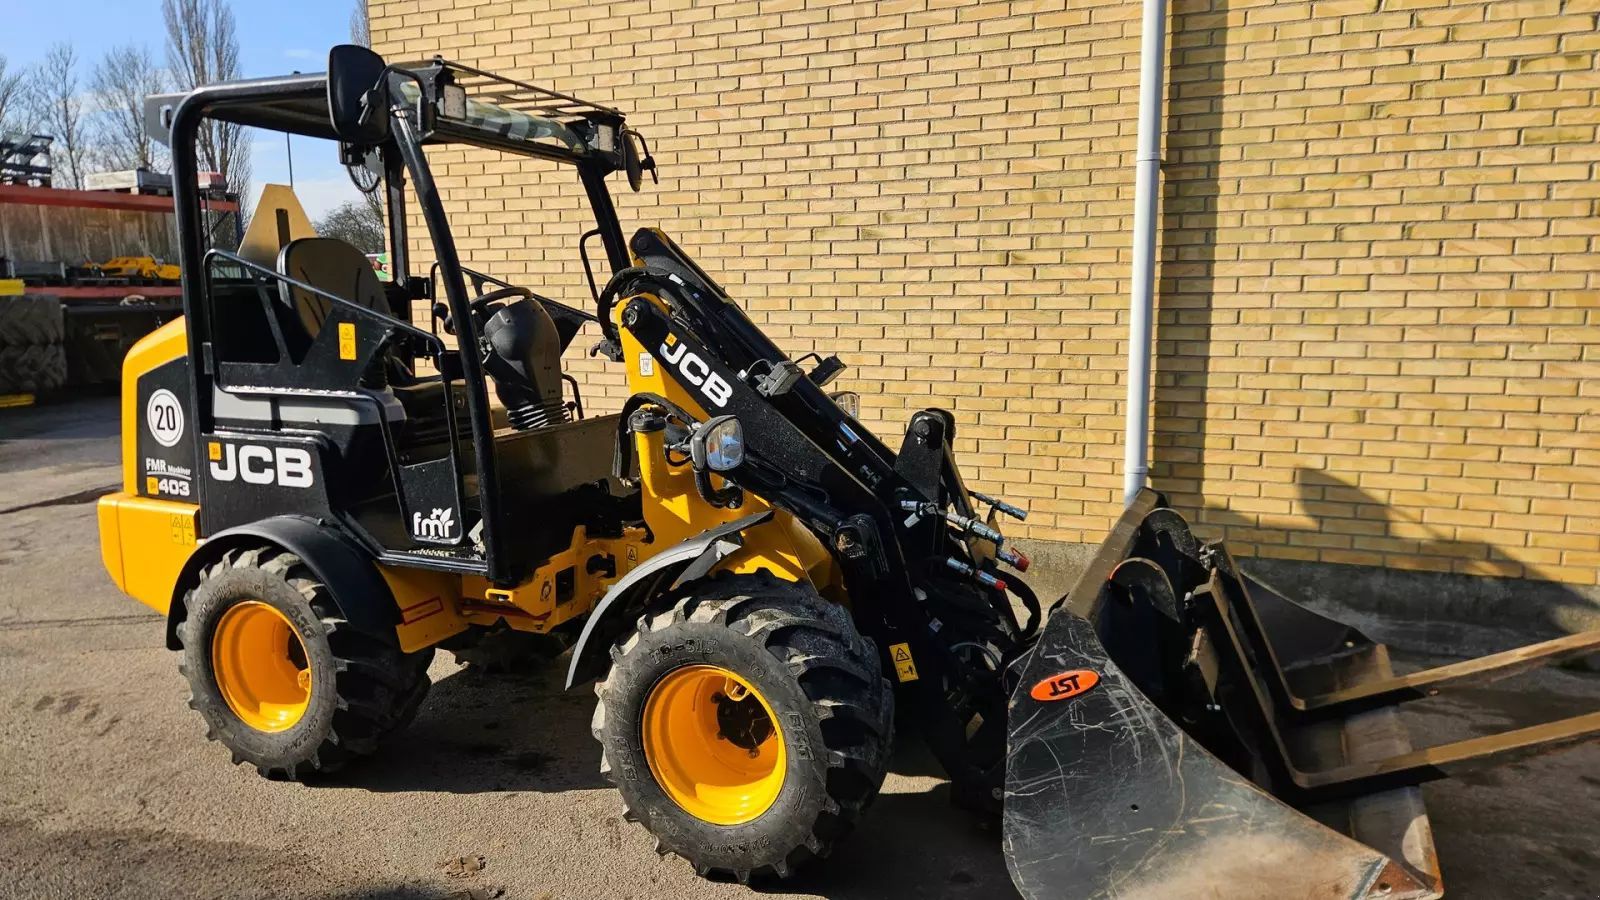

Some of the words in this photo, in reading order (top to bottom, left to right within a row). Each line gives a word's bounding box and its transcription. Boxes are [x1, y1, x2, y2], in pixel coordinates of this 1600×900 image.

[660, 338, 733, 408] JCB
[155, 405, 176, 431] 20
[145, 457, 167, 472] FMR
[209, 443, 314, 488] JCB
[158, 478, 190, 496] 403
[413, 511, 455, 538] fmr
[1049, 674, 1080, 697] JST
